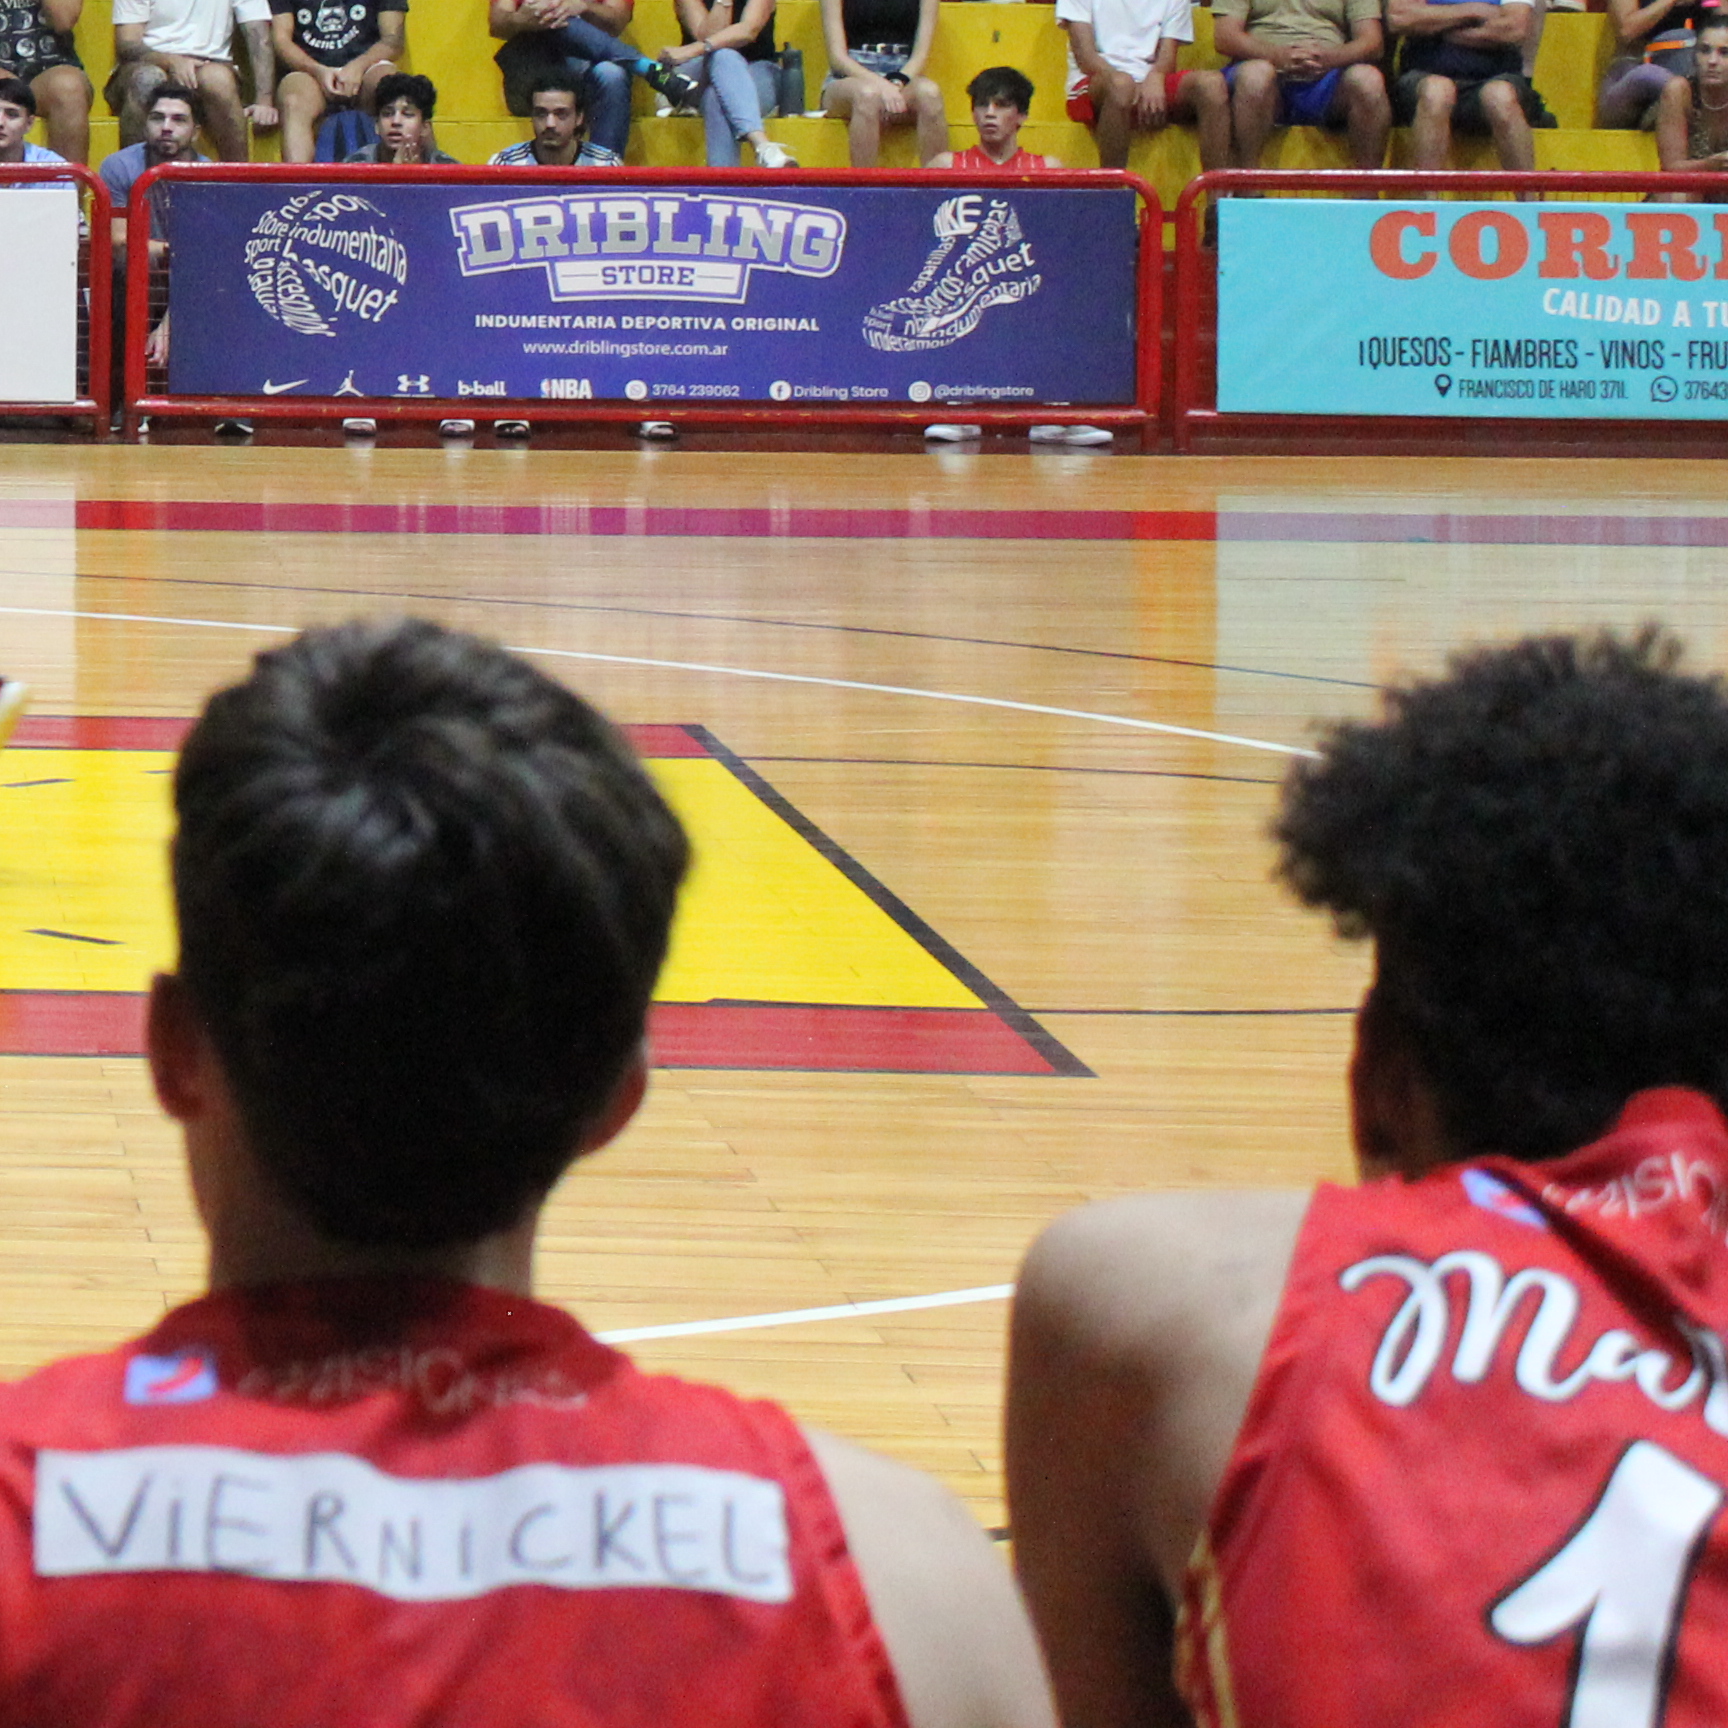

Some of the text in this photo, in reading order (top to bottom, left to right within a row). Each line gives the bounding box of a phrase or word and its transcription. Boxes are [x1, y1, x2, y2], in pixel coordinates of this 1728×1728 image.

[458, 199, 841, 270] DRIBLING
[1369, 209, 1728, 282] CORR
[602, 265, 696, 287] STORE
[1543, 287, 1662, 327] CALIDAD
[1671, 300, 1693, 329] A
[475, 314, 820, 332] INDUMENTARIA DEPORTIVA ORIGINAL
[523, 340, 729, 358] www.driblingstore.com.ar
[1471, 339, 1579, 370] FIAMBRES
[1600, 340, 1666, 370] VINOS
[1688, 341, 1728, 371] FRU
[458, 378, 593, 400] b-ball NBA
[652, 384, 686, 397] 3764
[794, 384, 890, 401] Dribling Store
[934, 383, 1035, 400] @driblingstore
[1459, 379, 1534, 399] FRANCISCO
[1539, 379, 1555, 399] DE
[1560, 379, 1595, 399] HARO
[58, 1471, 778, 1588] VIERNICKEL
